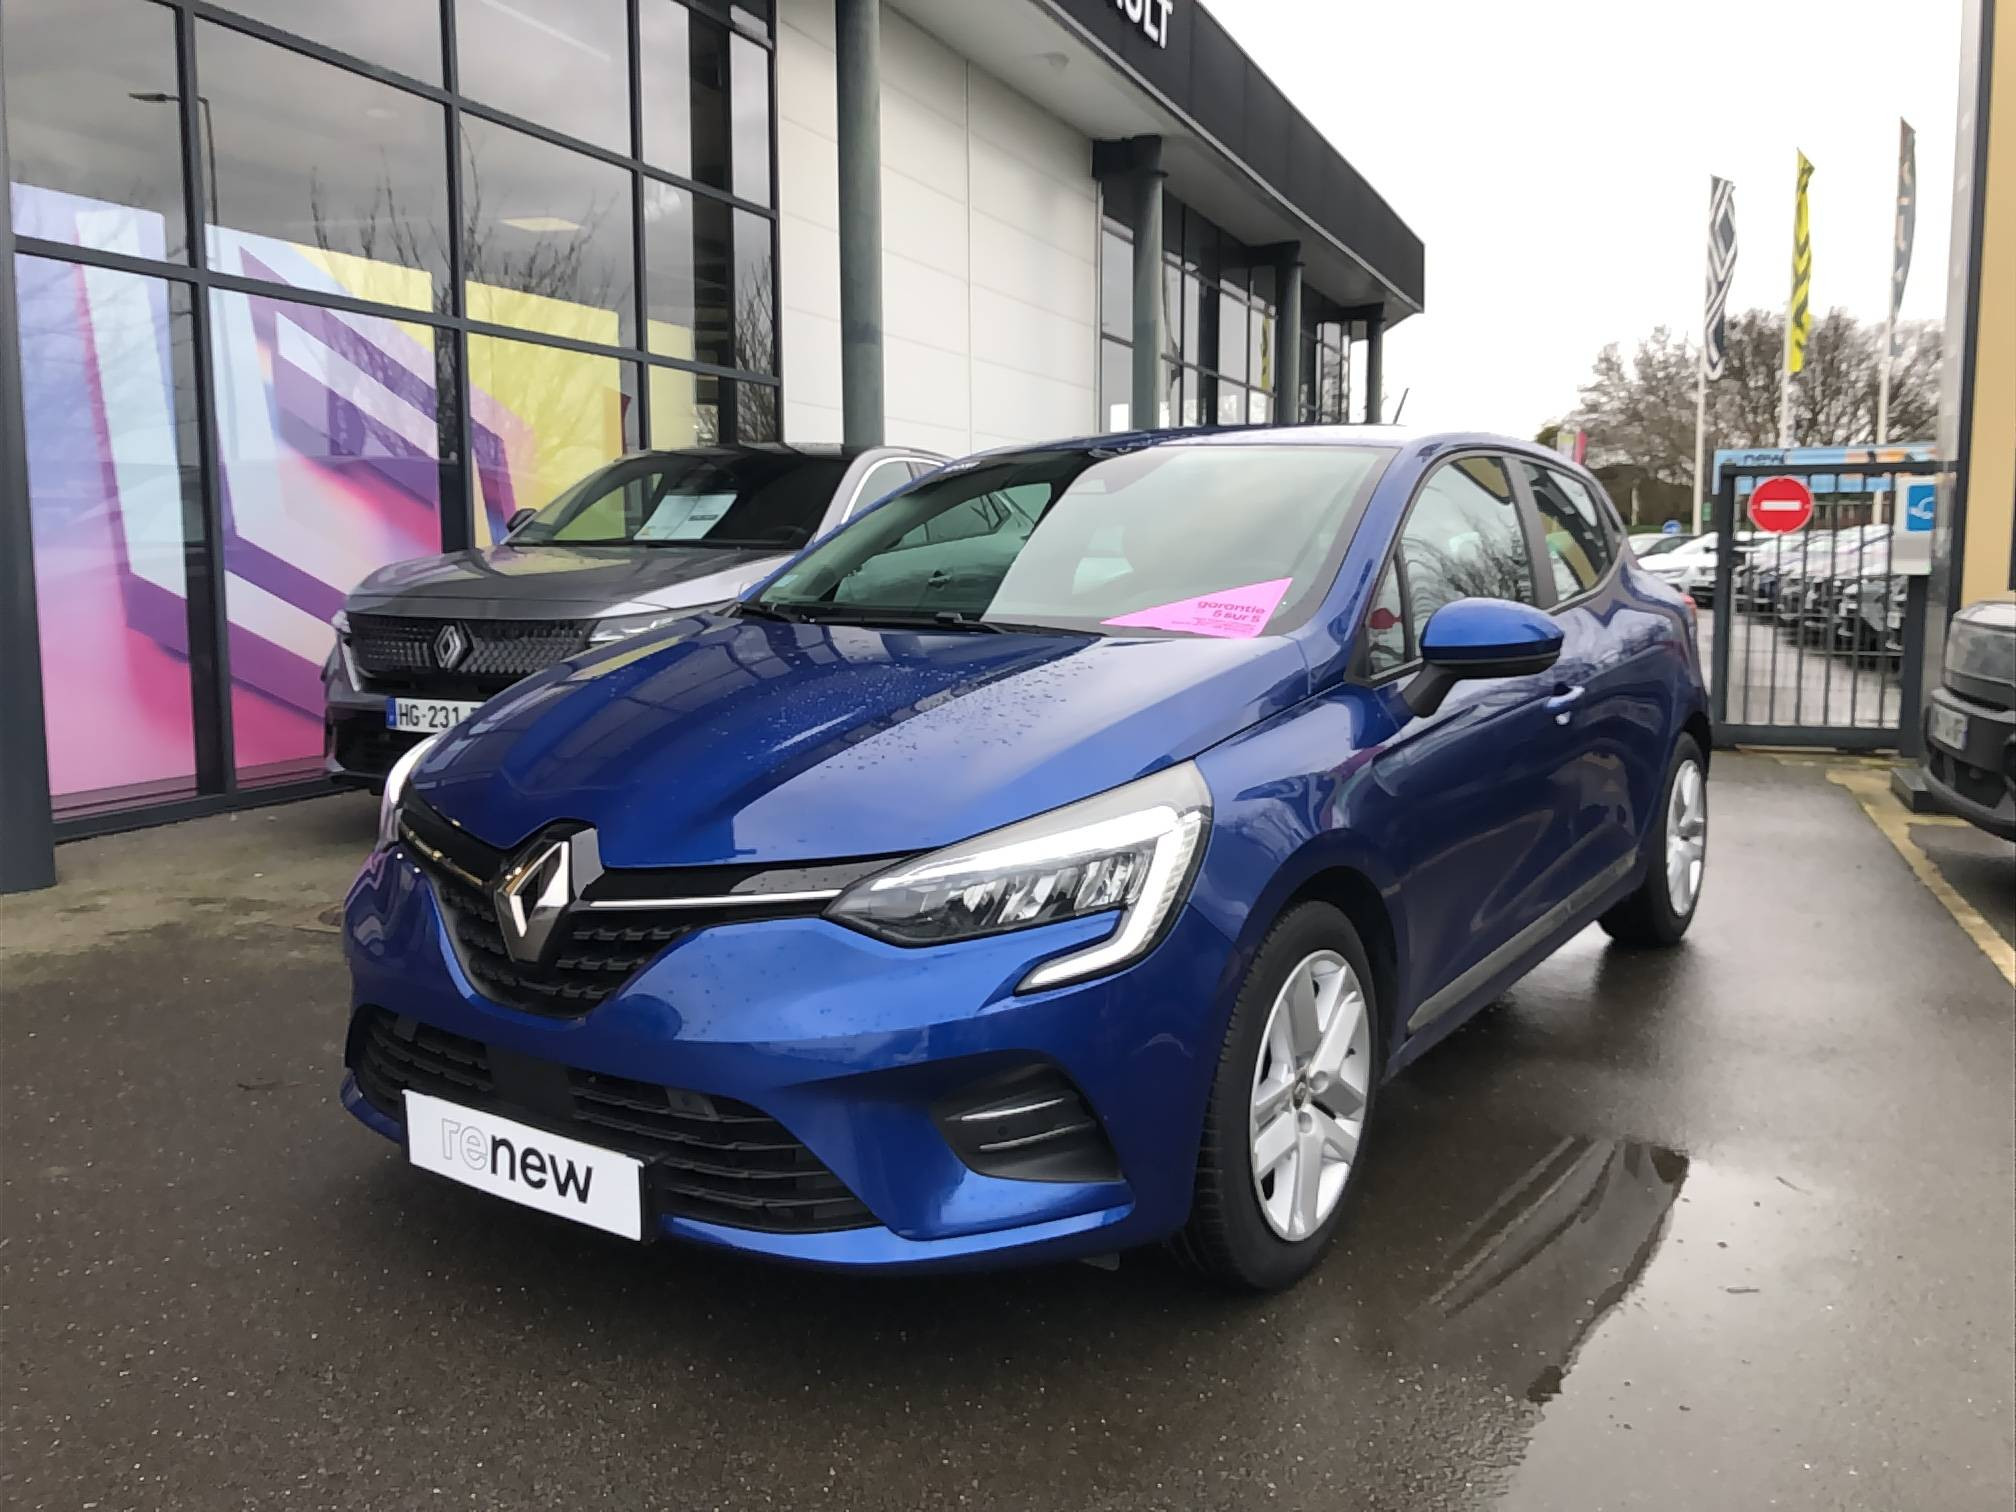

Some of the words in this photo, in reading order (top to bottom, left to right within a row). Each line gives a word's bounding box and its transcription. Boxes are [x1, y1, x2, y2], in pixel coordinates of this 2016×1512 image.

[1197, 601, 1265, 614] garantie
[1223, 612, 1249, 621] sur
[398, 703, 480, 729] HG-231
[441, 1118, 593, 1204] renew
